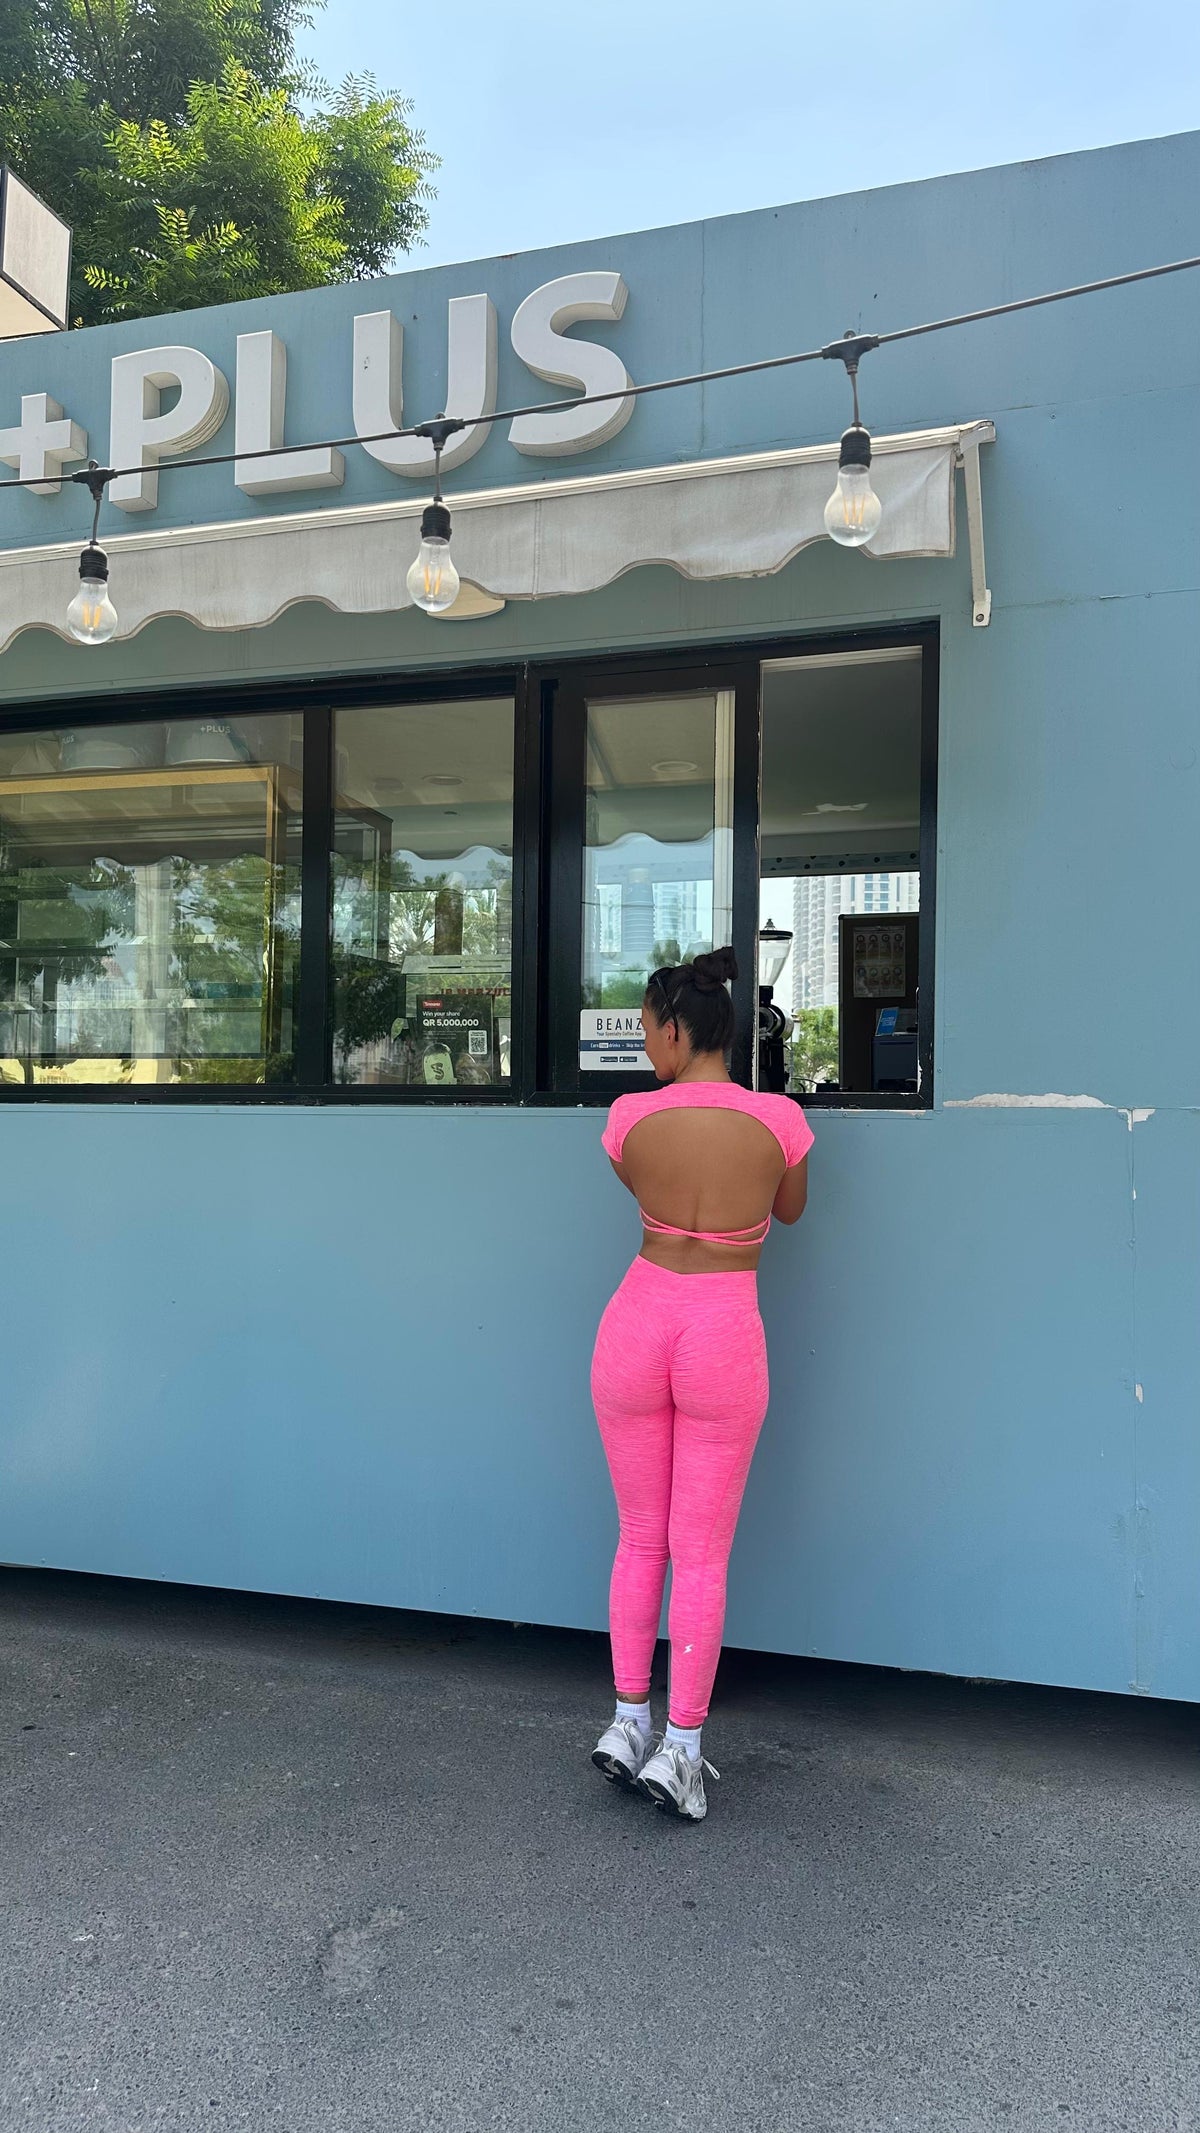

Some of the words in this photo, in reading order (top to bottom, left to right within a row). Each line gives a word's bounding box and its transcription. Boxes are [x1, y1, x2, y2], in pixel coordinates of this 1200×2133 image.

[0, 271, 637, 513] +PLUS
[422, 1019, 436, 1027] QR
[436, 1019, 479, 1027] 5,000,000
[596, 1018, 642, 1031] BEANZ
